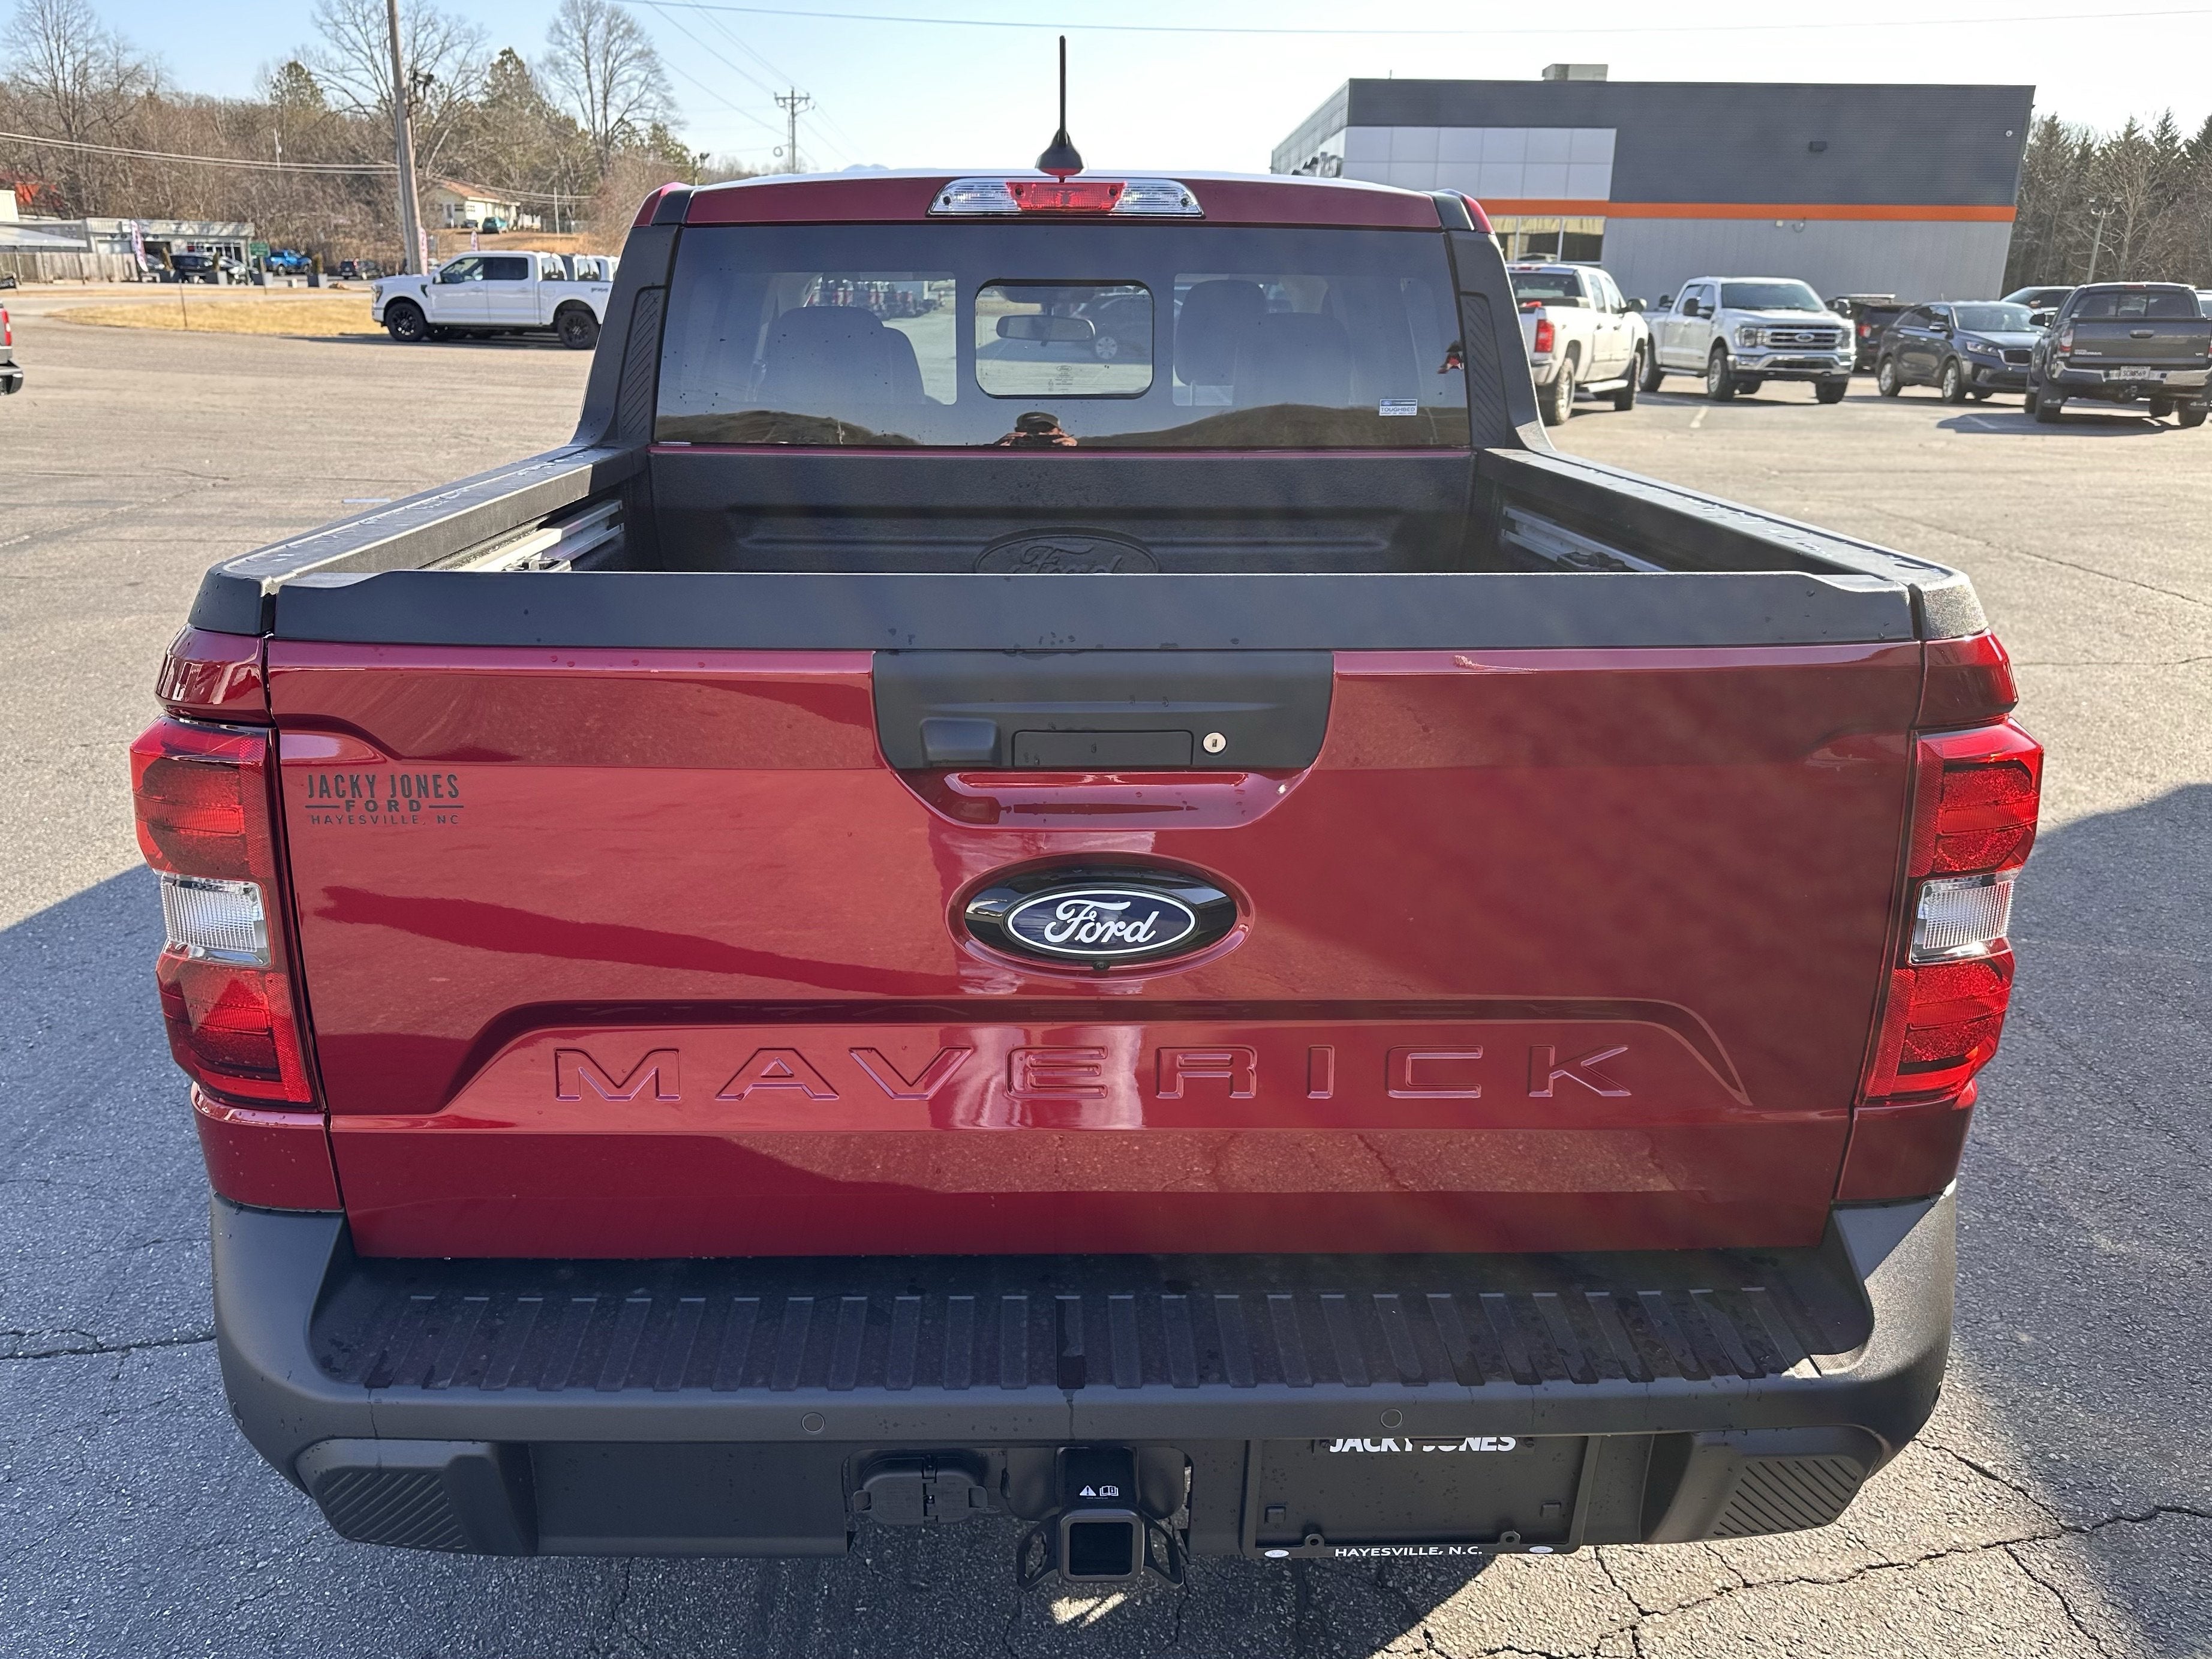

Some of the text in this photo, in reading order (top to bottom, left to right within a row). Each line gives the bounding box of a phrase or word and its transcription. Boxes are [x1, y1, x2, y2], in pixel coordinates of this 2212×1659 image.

[308, 774, 459, 798] JACKY JONES
[345, 800, 422, 812] FORD
[437, 815, 459, 824] NC
[1044, 899, 1159, 943] Ford
[555, 1046, 1631, 1101] MAVERICK
[1329, 1438, 1413, 1453] JACKY
[1335, 1546, 1483, 1556] HAYESVILLE, N.C.
